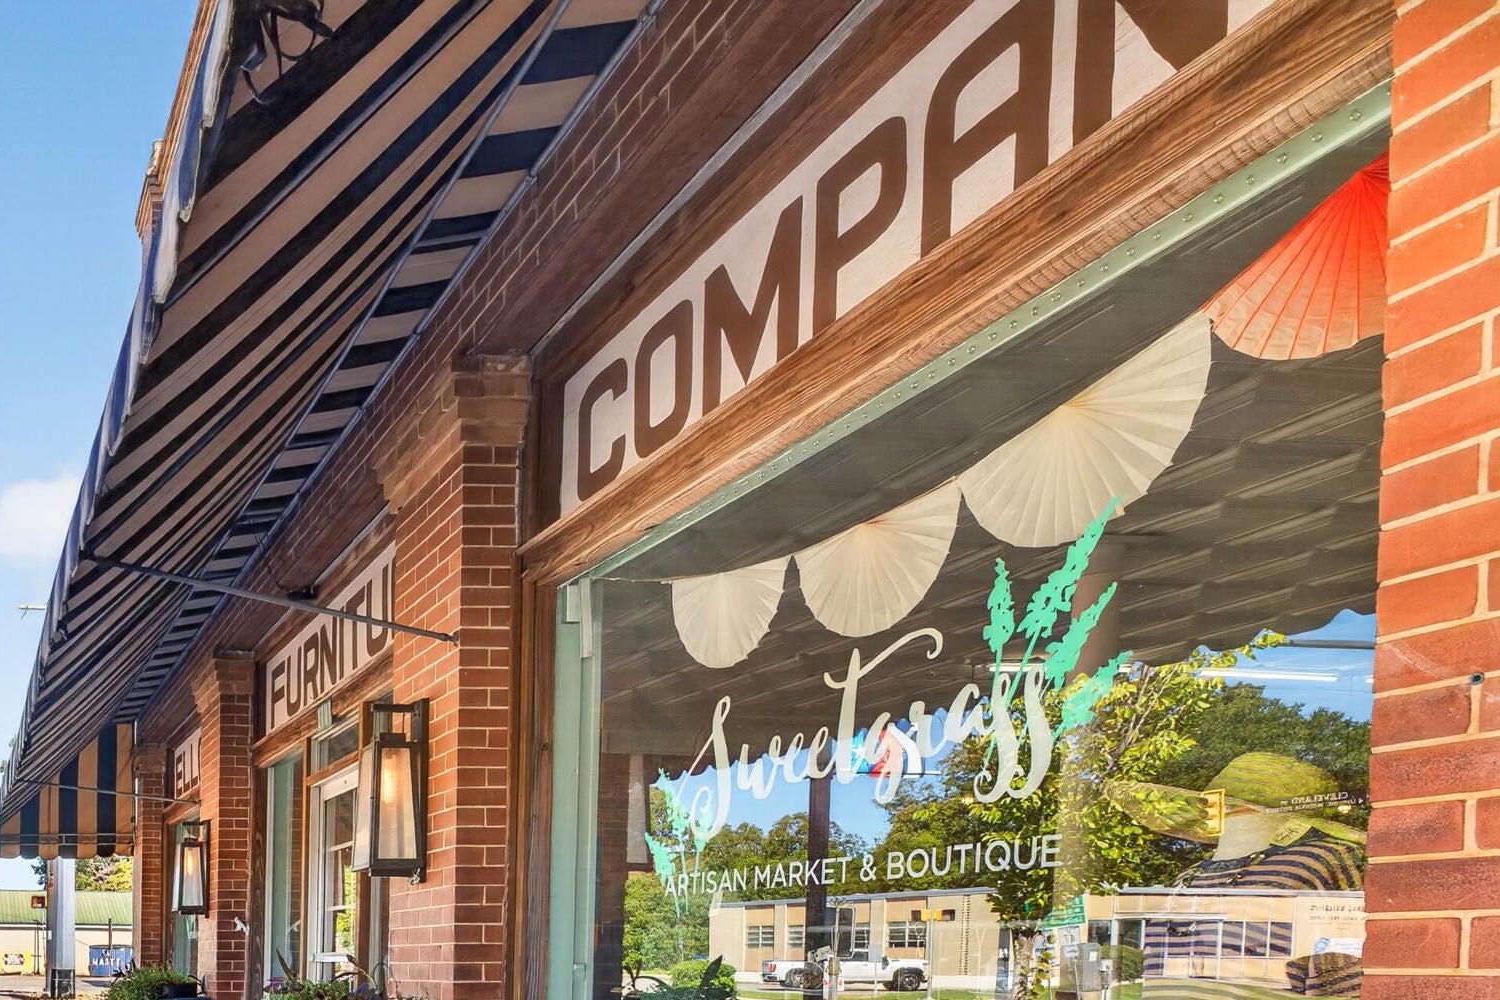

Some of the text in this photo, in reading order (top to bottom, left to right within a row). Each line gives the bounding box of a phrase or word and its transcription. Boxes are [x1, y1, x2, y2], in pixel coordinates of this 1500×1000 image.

[271, 557, 396, 730] FURNITU
[176, 737, 201, 798] ELL
[682, 627, 1053, 841] Sweetgrass
[664, 834, 1063, 898] ARTISAN MARKET & BOUTIQUE
